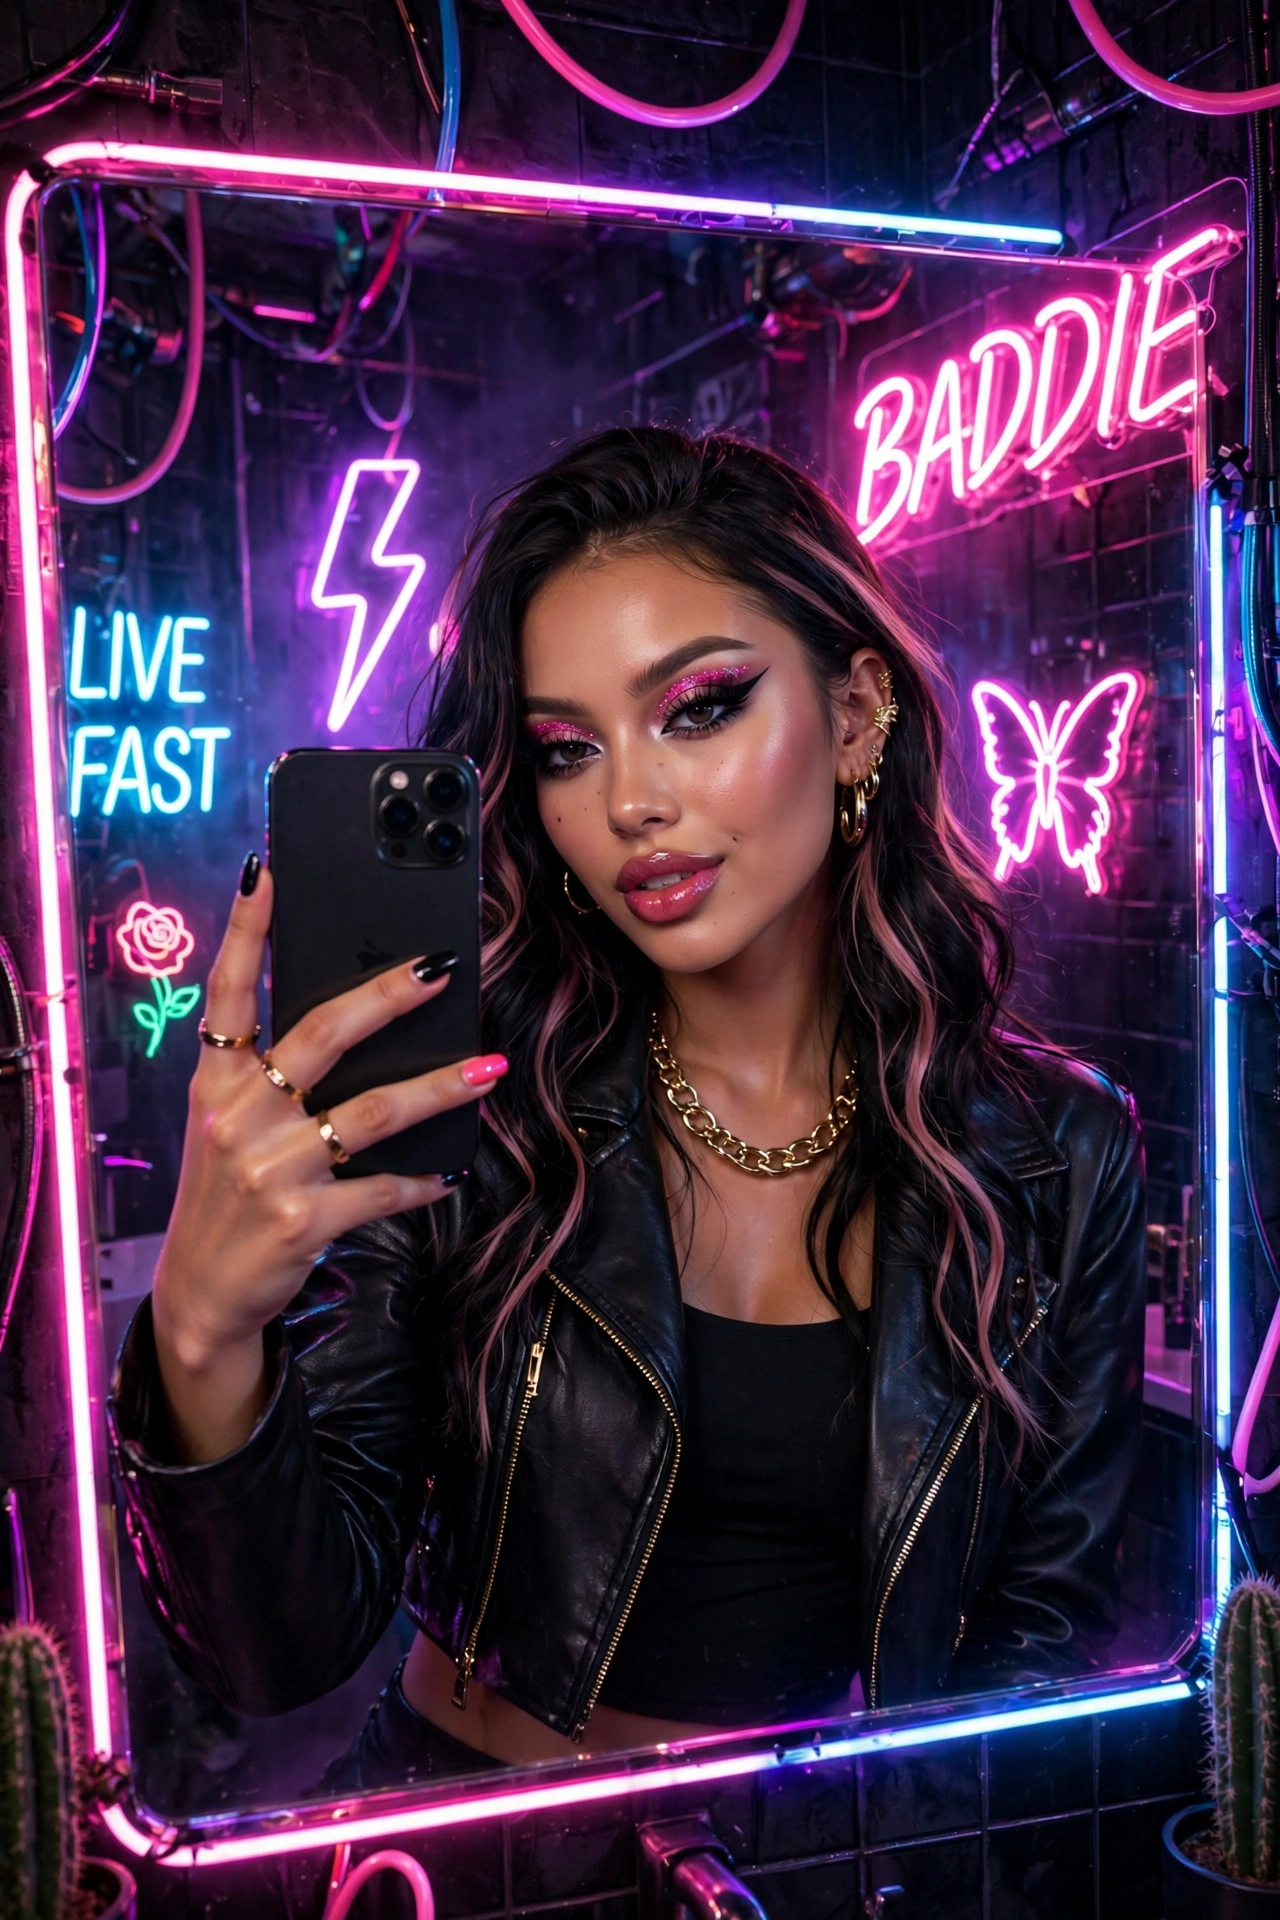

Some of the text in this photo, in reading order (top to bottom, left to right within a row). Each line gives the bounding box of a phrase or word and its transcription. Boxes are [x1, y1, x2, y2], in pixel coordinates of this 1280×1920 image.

[853, 227, 1221, 546] BADDIE
[70, 605, 210, 703] LIVE
[70, 725, 232, 818] FAST
